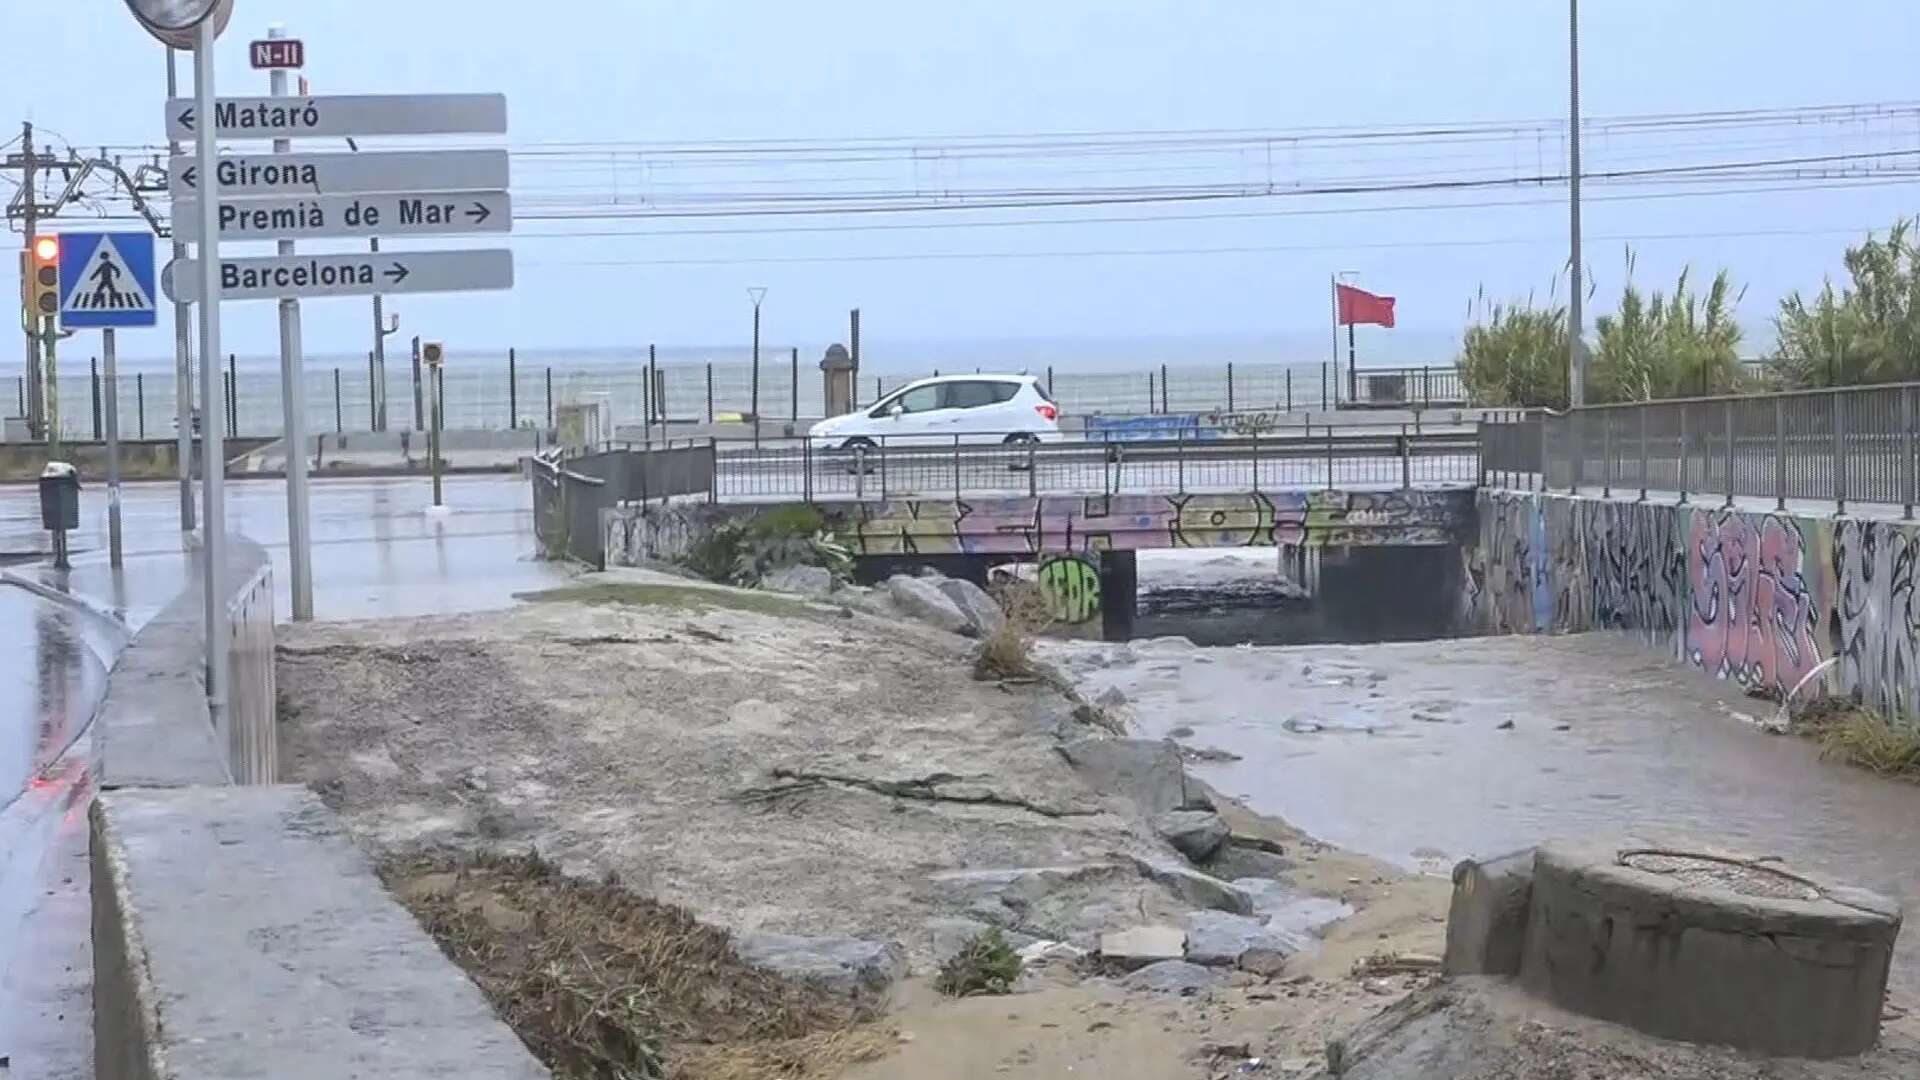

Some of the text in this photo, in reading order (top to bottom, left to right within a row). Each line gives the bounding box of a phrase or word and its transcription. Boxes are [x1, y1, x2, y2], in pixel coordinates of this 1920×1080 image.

[215, 101, 319, 128] Mataró
[217, 160, 317, 186] Girona
[219, 200, 455, 230] Premià de Mar
[221, 261, 374, 289] Barcelona
